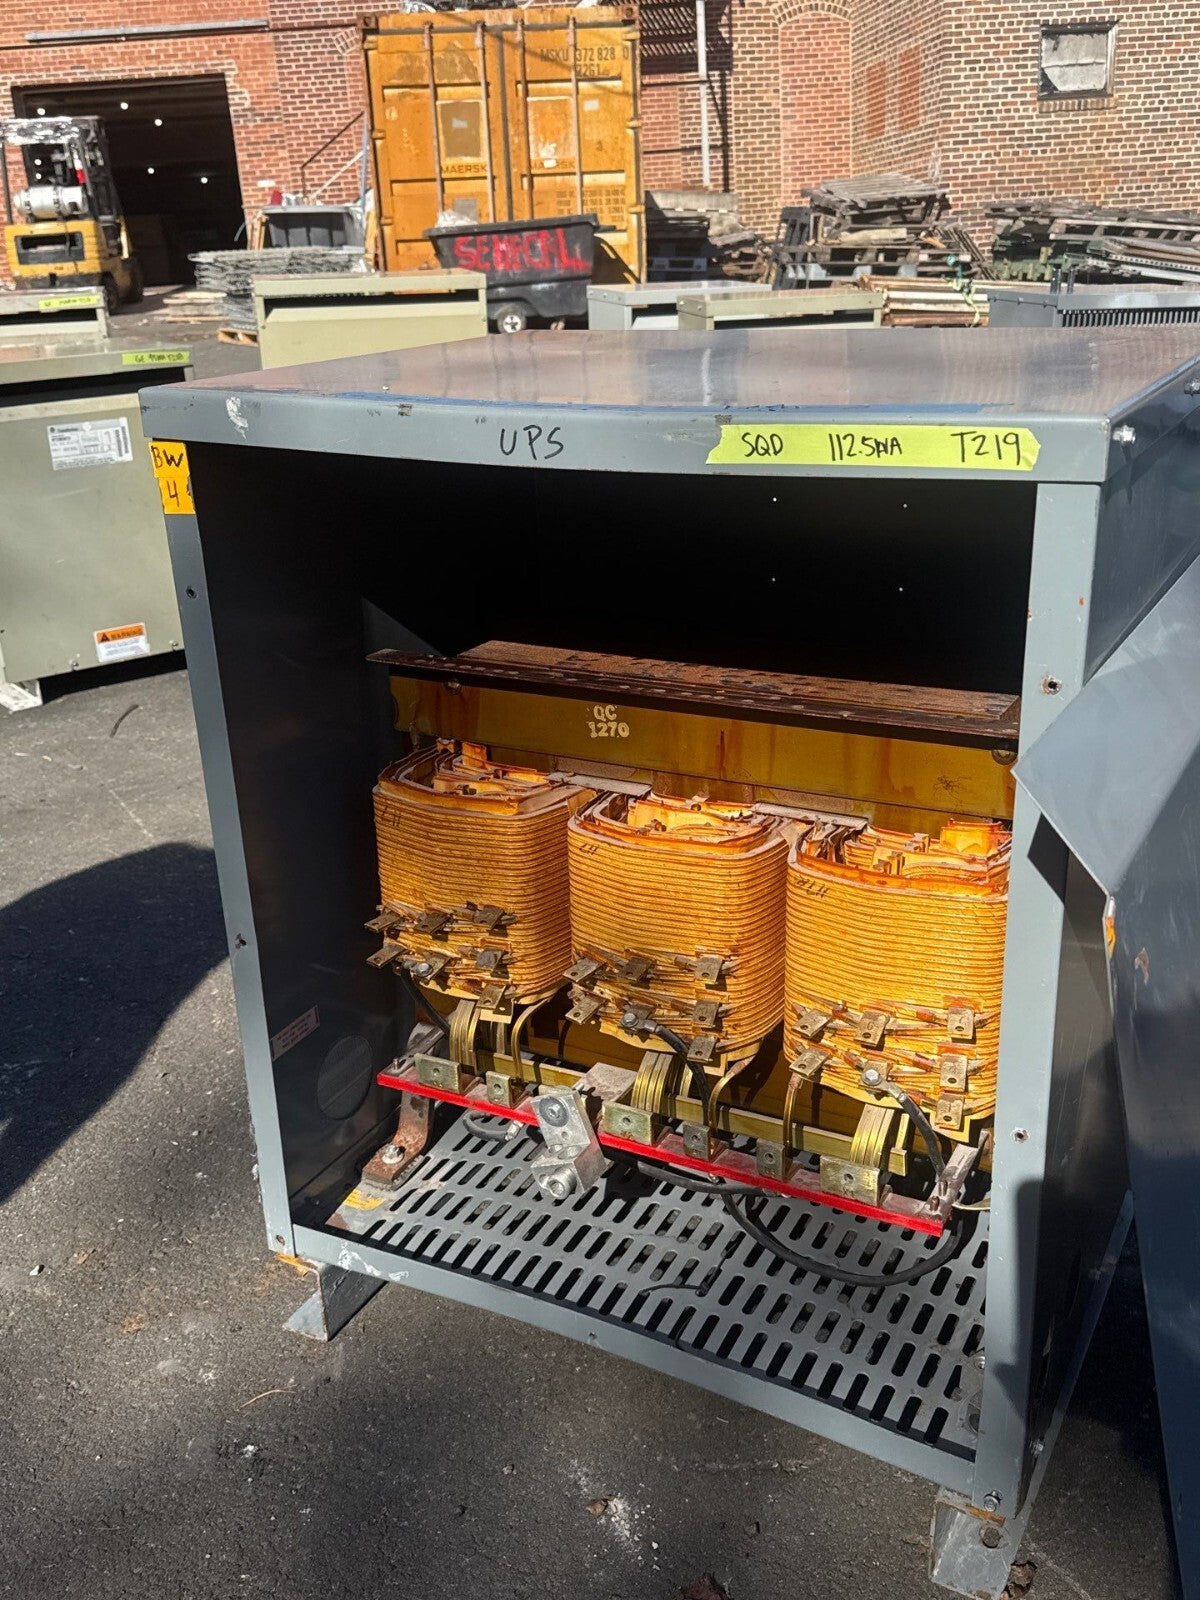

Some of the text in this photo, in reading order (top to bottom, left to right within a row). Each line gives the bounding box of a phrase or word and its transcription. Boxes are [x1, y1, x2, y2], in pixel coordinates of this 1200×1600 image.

[540, 48, 569, 62] MSKU
[575, 48, 595, 62] 372
[597, 46, 616, 61] 828
[440, 164, 488, 174] MAERSK
[500, 425, 564, 461] UPS
[741, 432, 784, 457] SQD
[950, 431, 1021, 465] T219
[150, 445, 184, 469] BW
[166, 480, 180, 508] 4
[593, 704, 617, 722] QC
[588, 721, 630, 738] 1270
